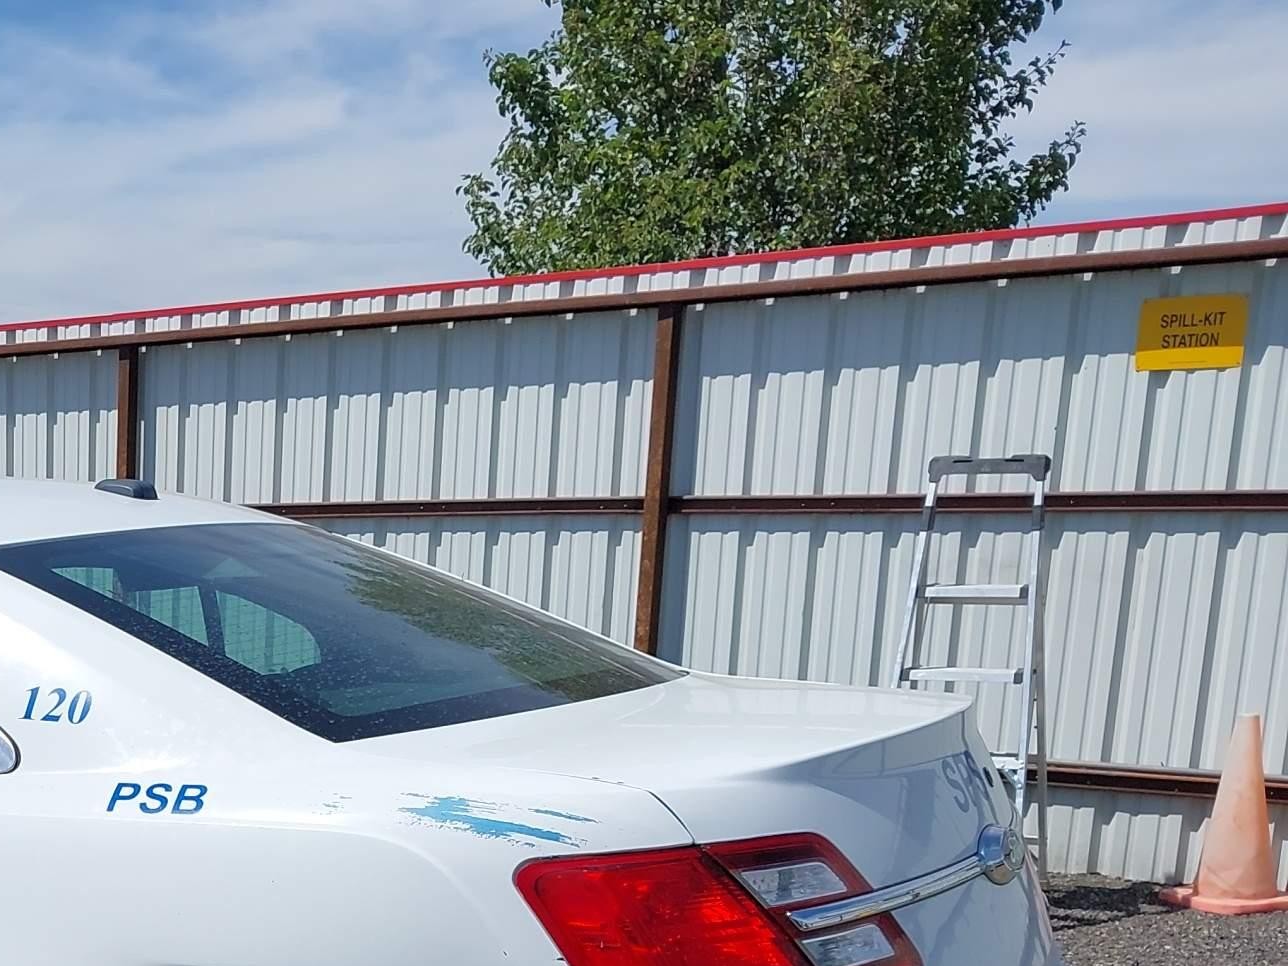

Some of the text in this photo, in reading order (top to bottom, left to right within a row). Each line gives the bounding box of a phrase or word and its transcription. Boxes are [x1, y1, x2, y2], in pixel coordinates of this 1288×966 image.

[1160, 311, 1226, 328] SPILL-KIT
[1161, 332, 1220, 348] STATION
[16, 686, 92, 724] 120
[106, 782, 208, 814] PSB
[942, 751, 990, 813] SPS
